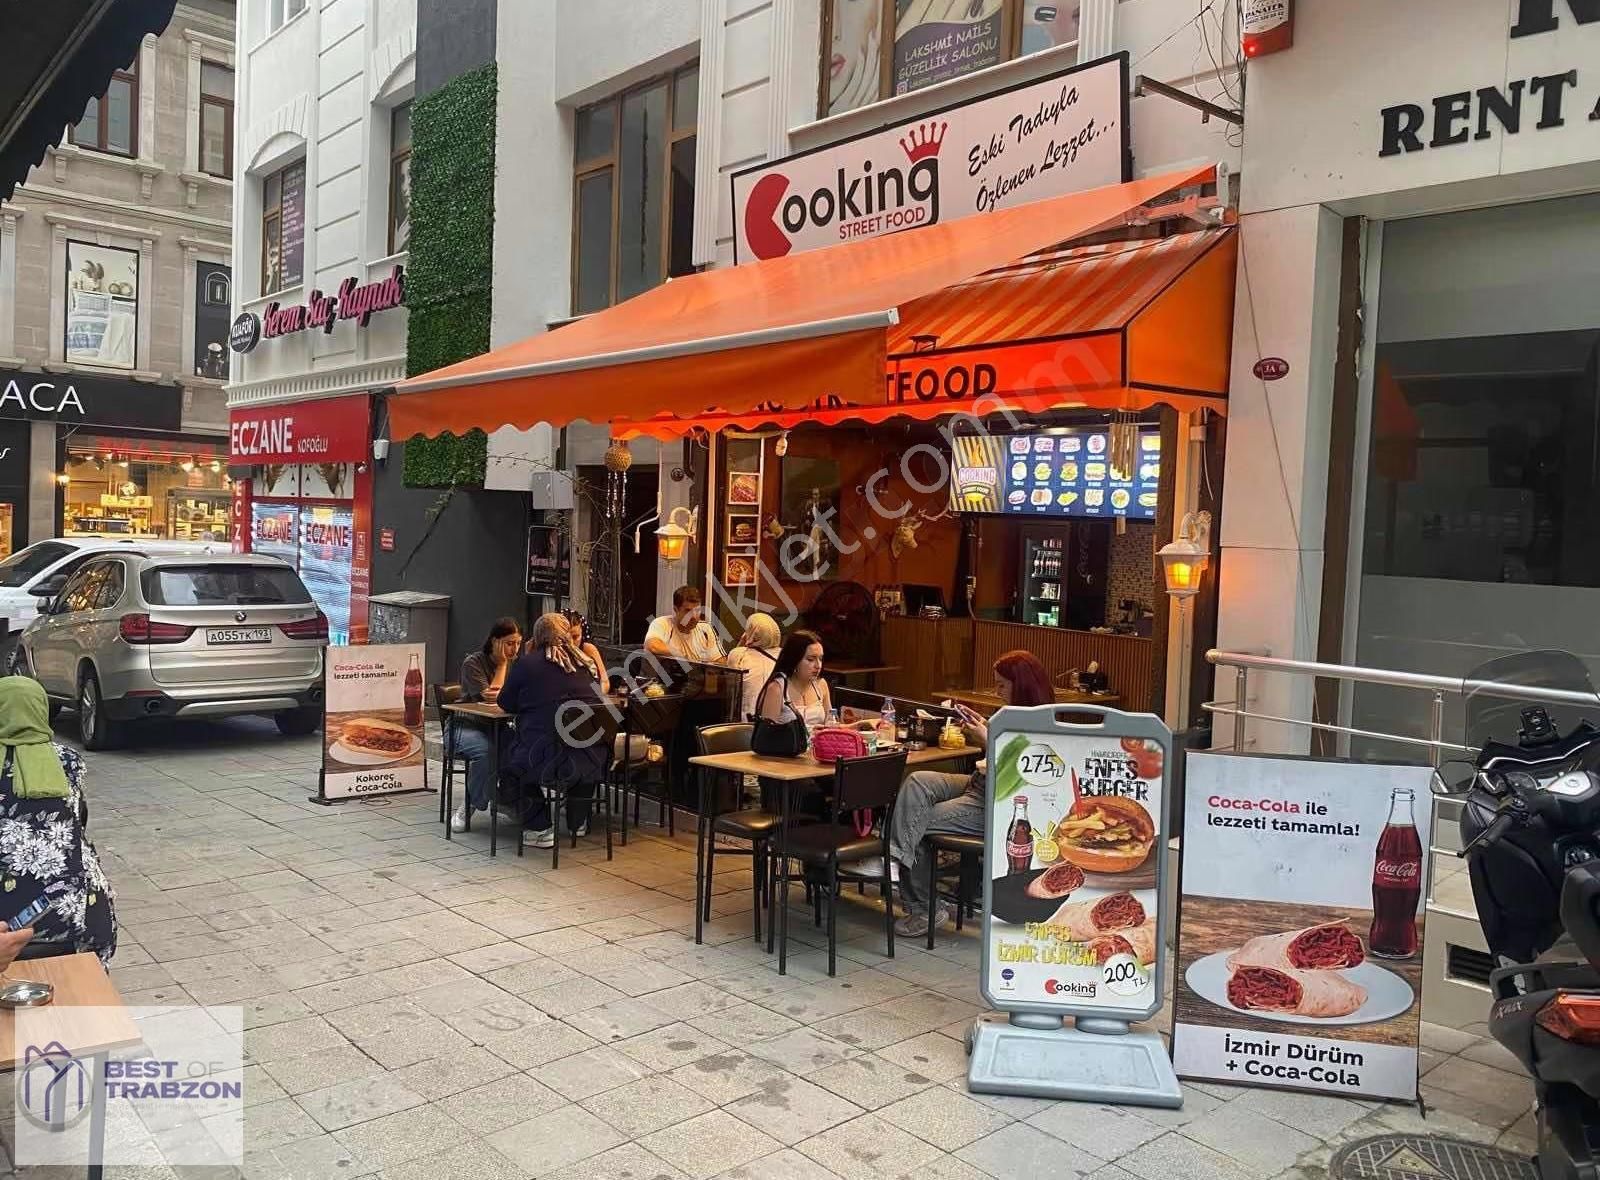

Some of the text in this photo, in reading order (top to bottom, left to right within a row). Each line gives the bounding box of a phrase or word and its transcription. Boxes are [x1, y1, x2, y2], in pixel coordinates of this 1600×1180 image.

[951, 37, 998, 63] SALONU
[1379, 70, 1577, 157] RENT
[968, 83, 1081, 177] Eski Tadıyla
[975, 164, 1036, 213] Özlenen
[745, 158, 939, 261] Cooking
[839, 206, 926, 240] STREET FOOD
[264, 302, 306, 338] Kerem
[338, 265, 405, 327] Kaynak
[0, 379, 86, 415] ACA
[231, 418, 294, 455] ECZANE
[256, 519, 292, 543] ECZANE
[305, 523, 350, 547] ECZANE
[334, 664, 373, 672] Coca-Cola
[334, 672, 360, 680] lezzeti
[1021, 754, 1056, 773] 275
[355, 782, 402, 793] Coca-Cola
[356, 773, 395, 784] Kokoreç
[1079, 777, 1149, 801] BURGER
[1208, 796, 1328, 816] Coca-Cola ile
[1208, 813, 1360, 836] lezzeti tamamla!
[1104, 962, 1136, 985] 200
[1045, 979, 1096, 998] Cooking
[1224, 1033, 1364, 1066] İzmir Dürüm
[1226, 1060, 1361, 1087] + Coca-Cola
